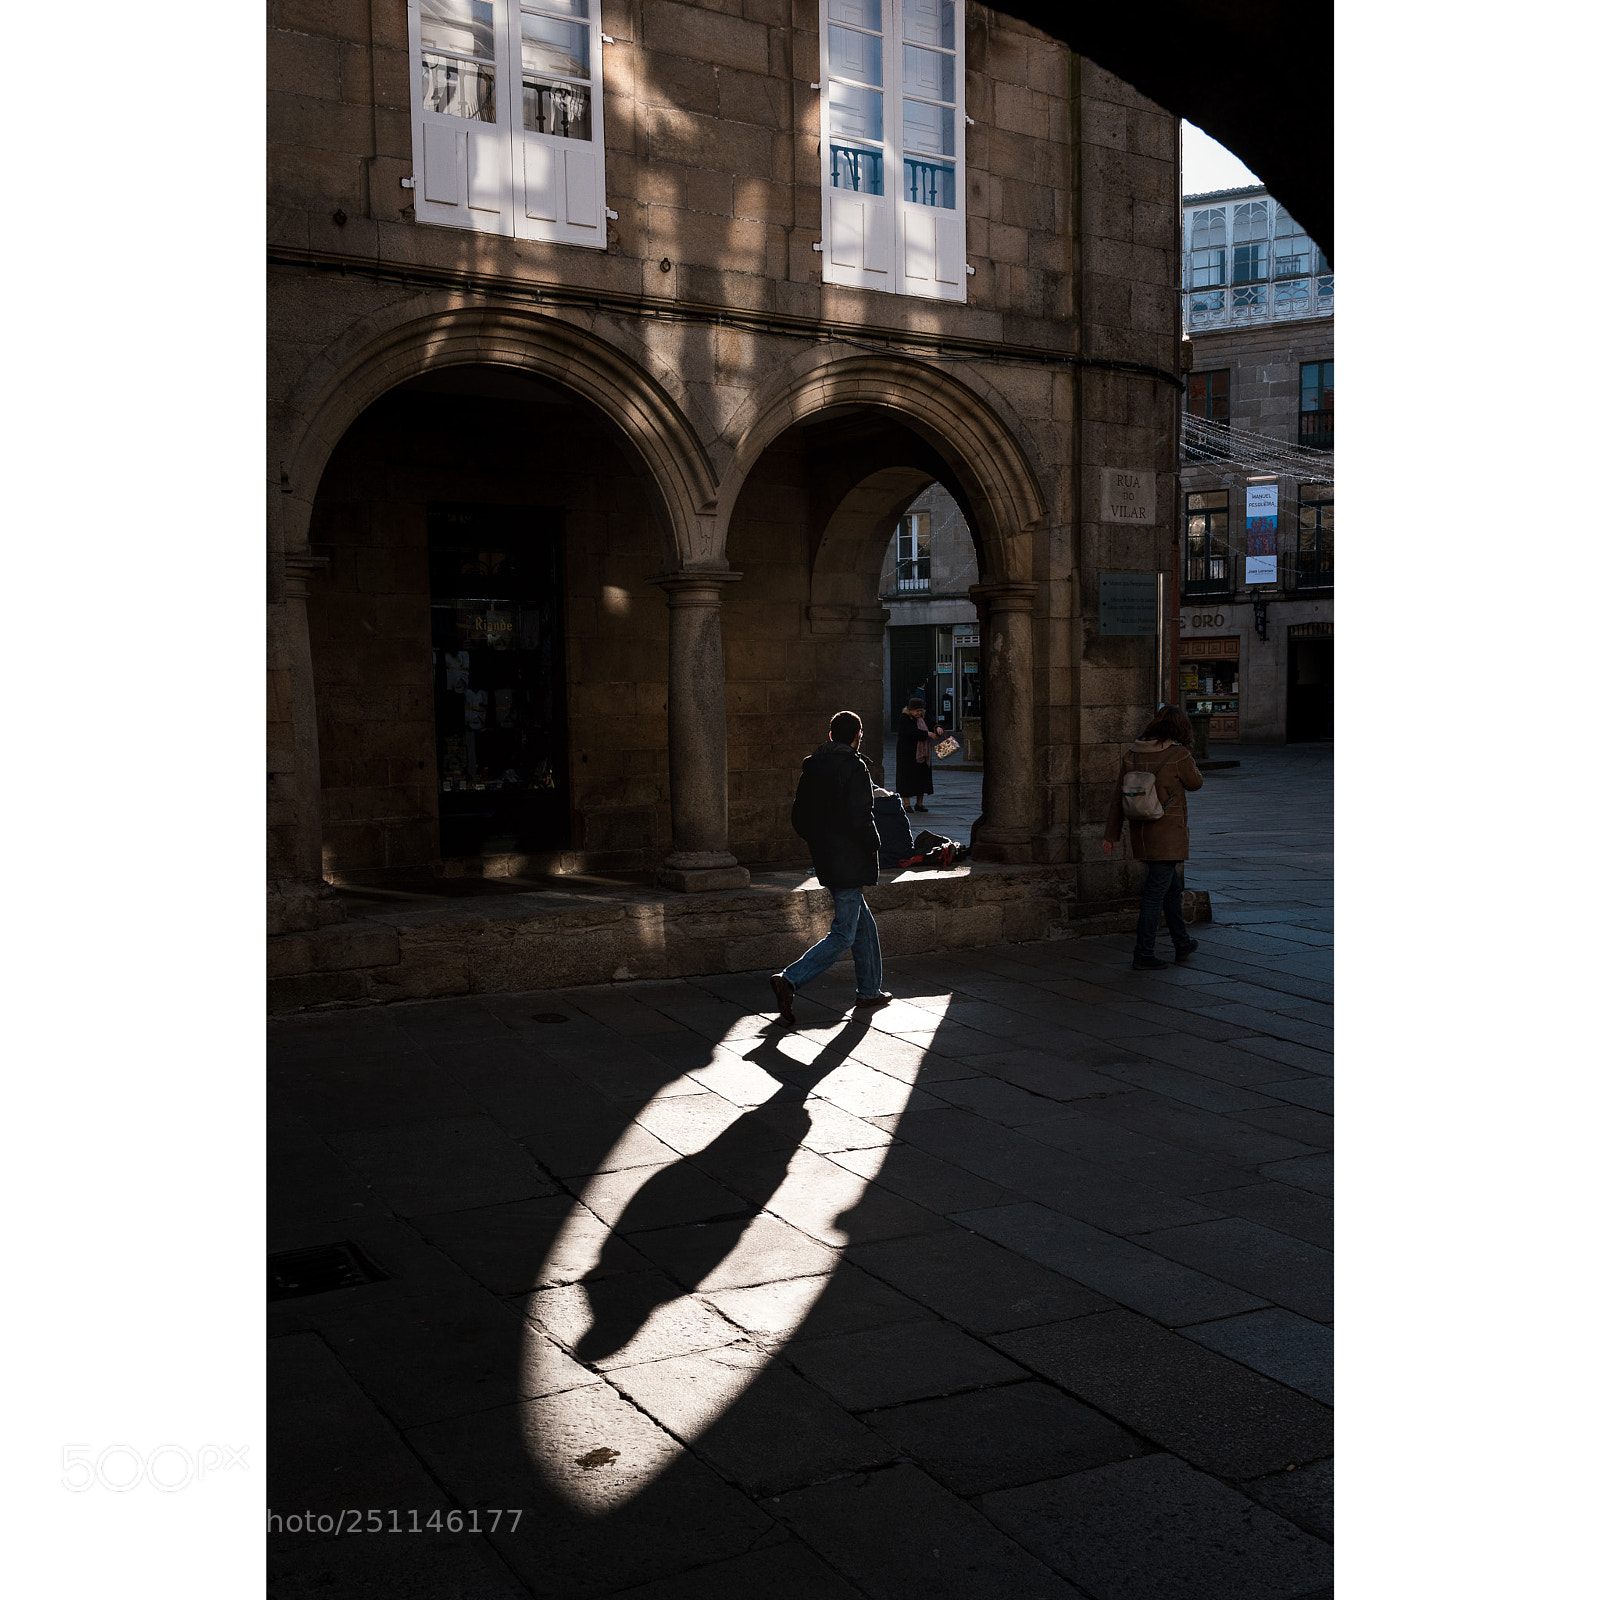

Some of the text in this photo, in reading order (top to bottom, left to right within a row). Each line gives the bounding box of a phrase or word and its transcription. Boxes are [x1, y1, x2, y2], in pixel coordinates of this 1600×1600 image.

[1117, 475, 1140, 488] RUA
[1123, 492, 1135, 500] DO
[1111, 504, 1146, 519] VILAR
[1191, 614, 1225, 628] ORO
